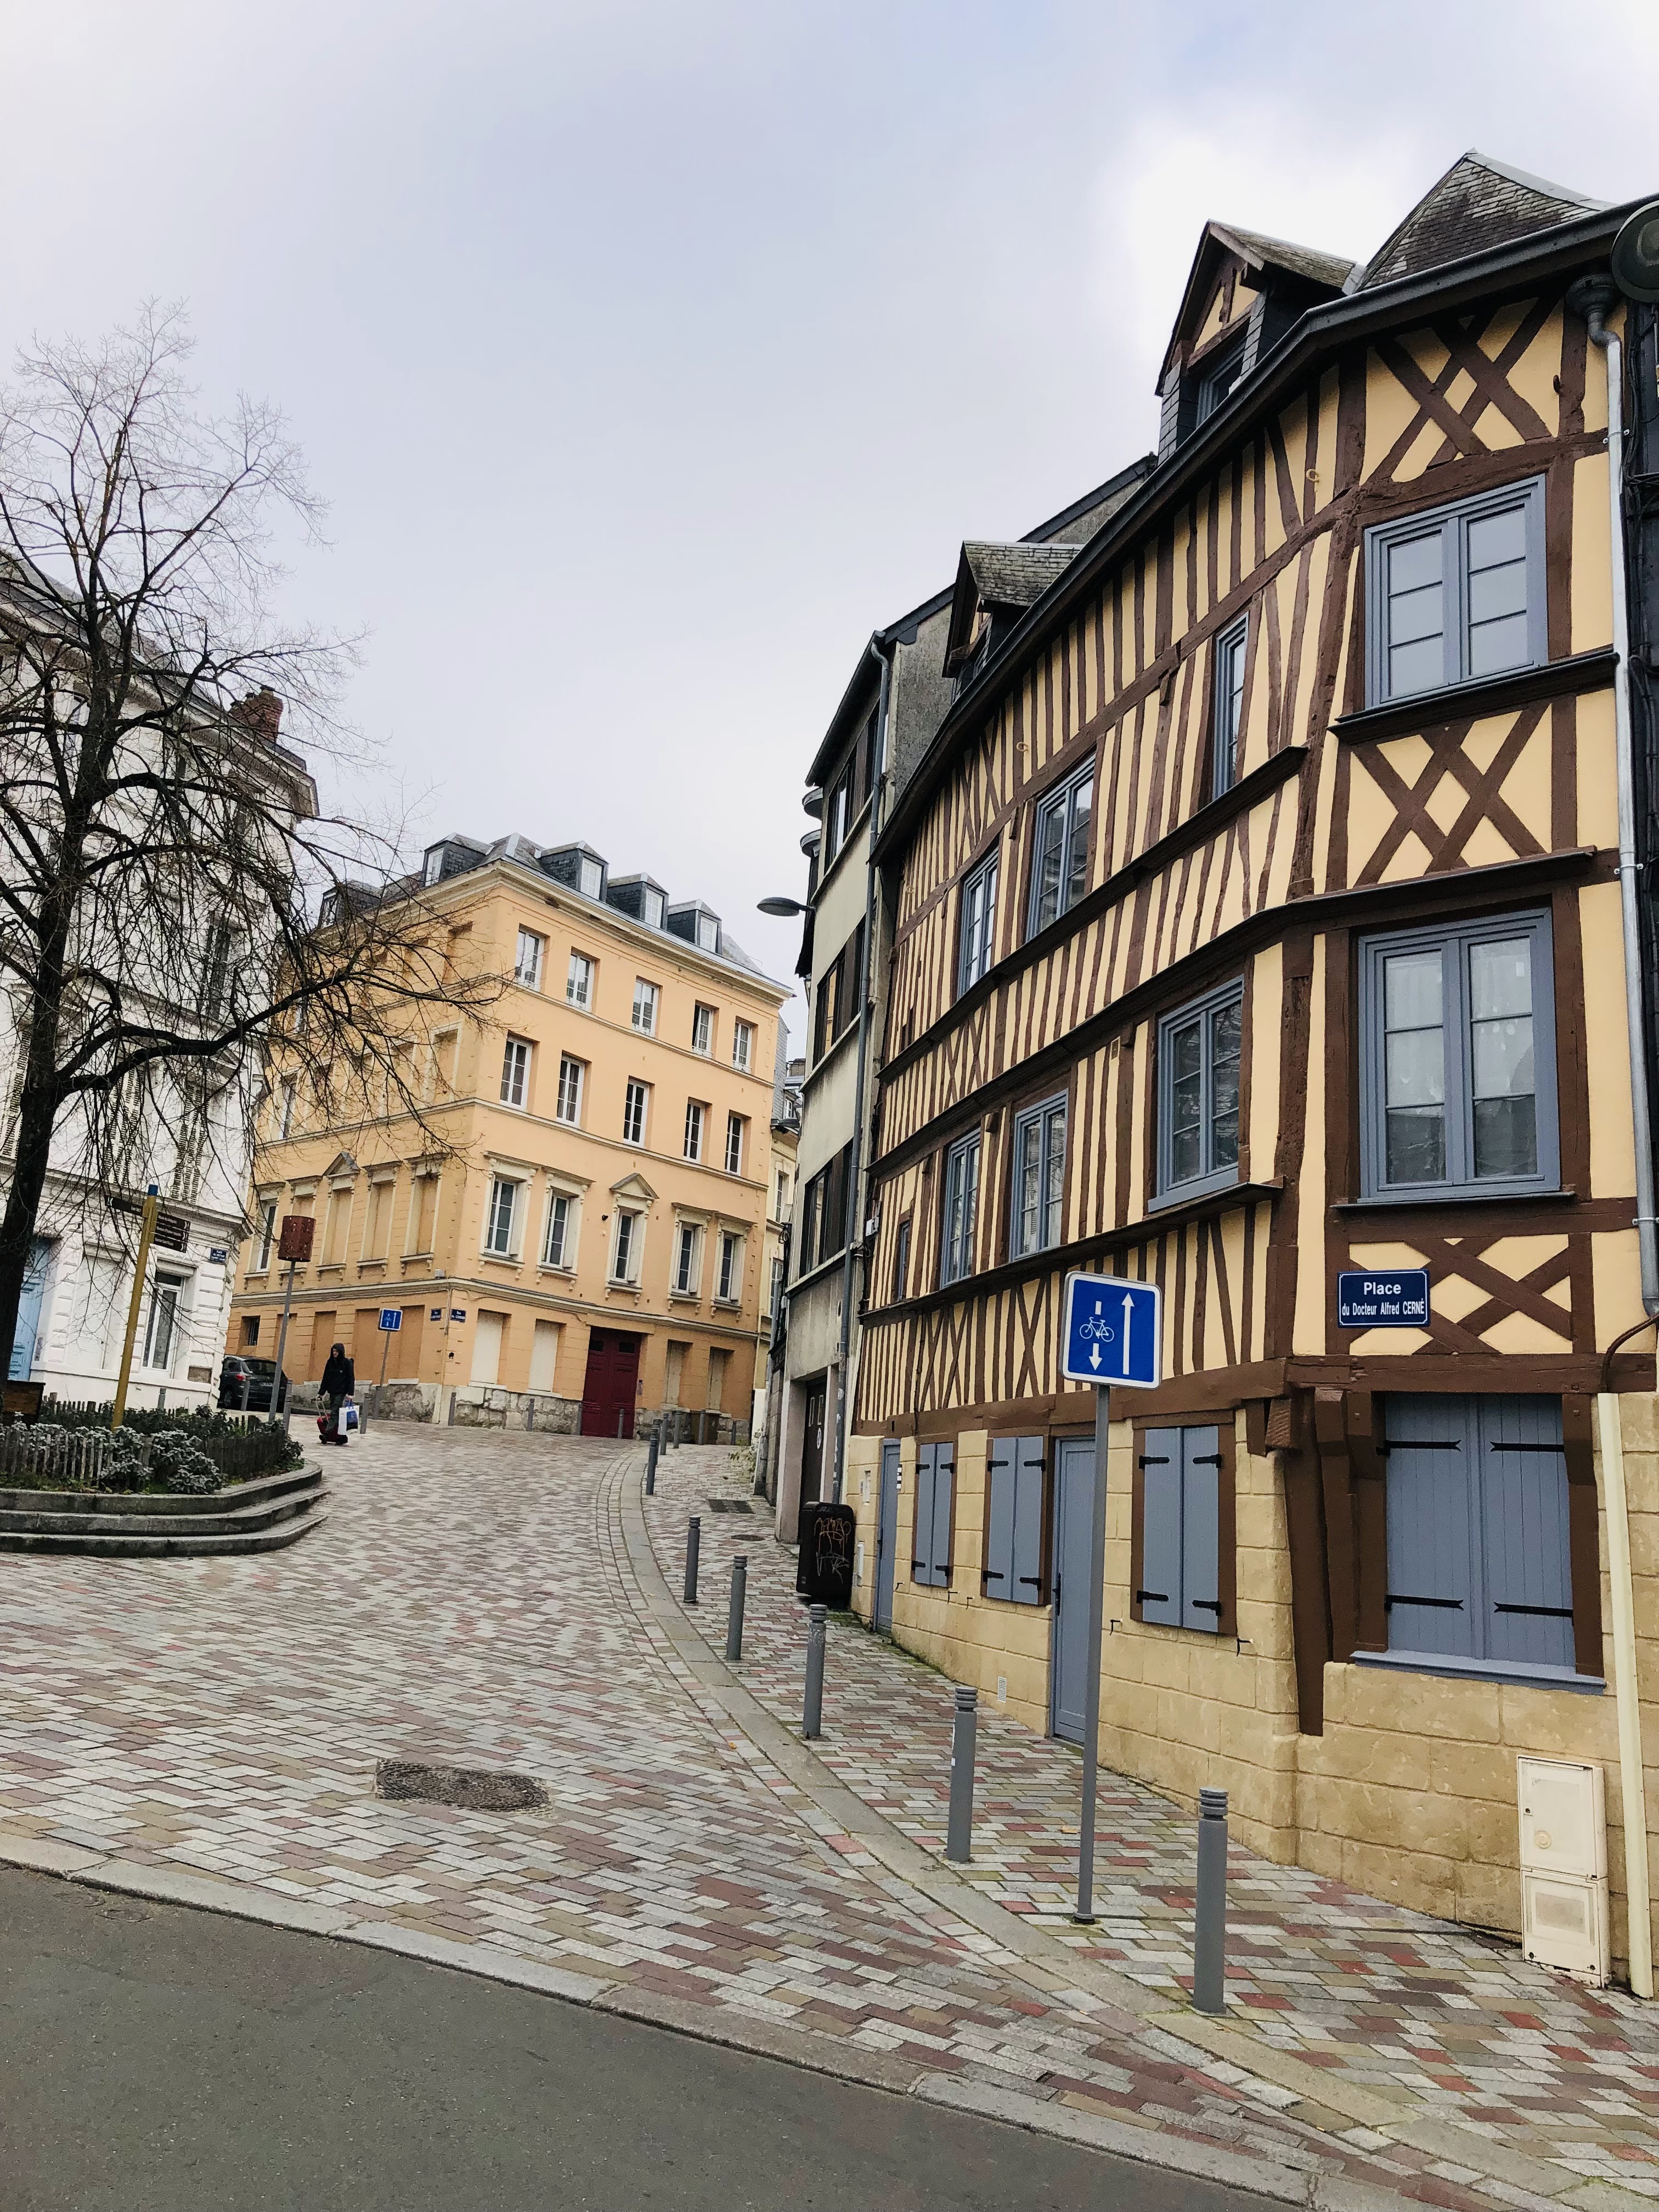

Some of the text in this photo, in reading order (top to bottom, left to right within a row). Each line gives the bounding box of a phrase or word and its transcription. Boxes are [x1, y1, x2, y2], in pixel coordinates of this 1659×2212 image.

[1364, 1282, 1401, 1295] Place
[1342, 1298, 1425, 1316] du Docteur Alfred CERNÉ
